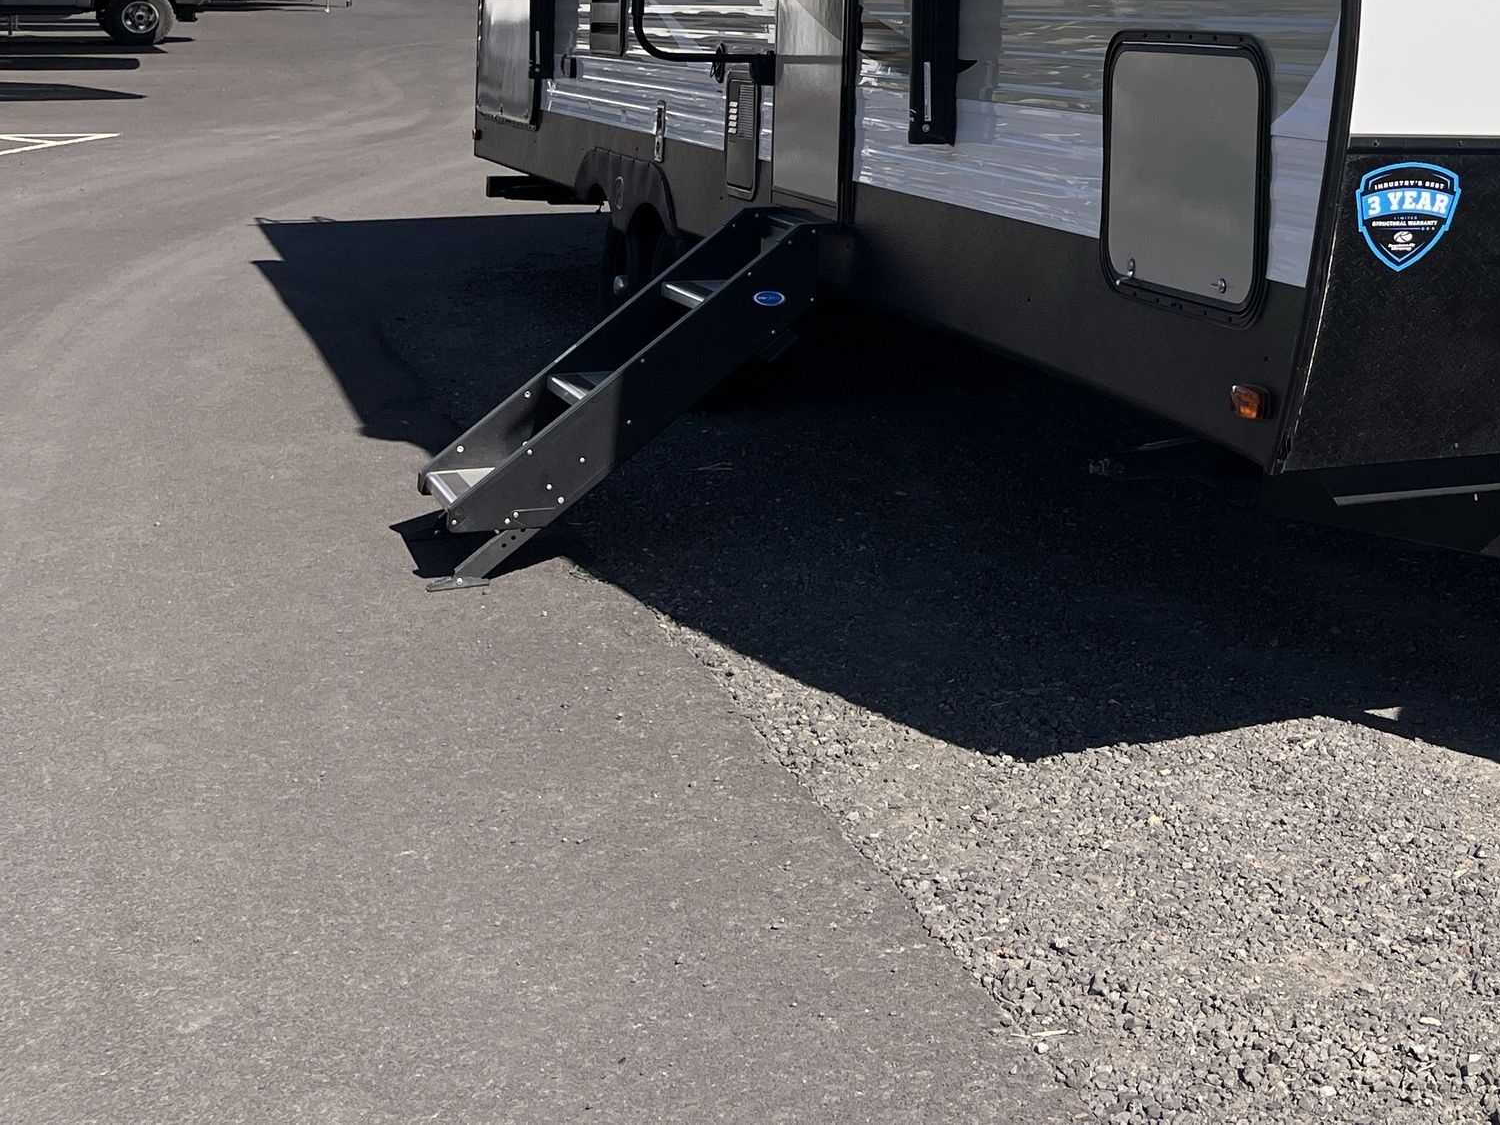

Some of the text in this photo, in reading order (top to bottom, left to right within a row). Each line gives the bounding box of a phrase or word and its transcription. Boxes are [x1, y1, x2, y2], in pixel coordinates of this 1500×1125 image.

[1425, 181, 1445, 190] BEST
[1367, 191, 1449, 215] 3 YEAR
